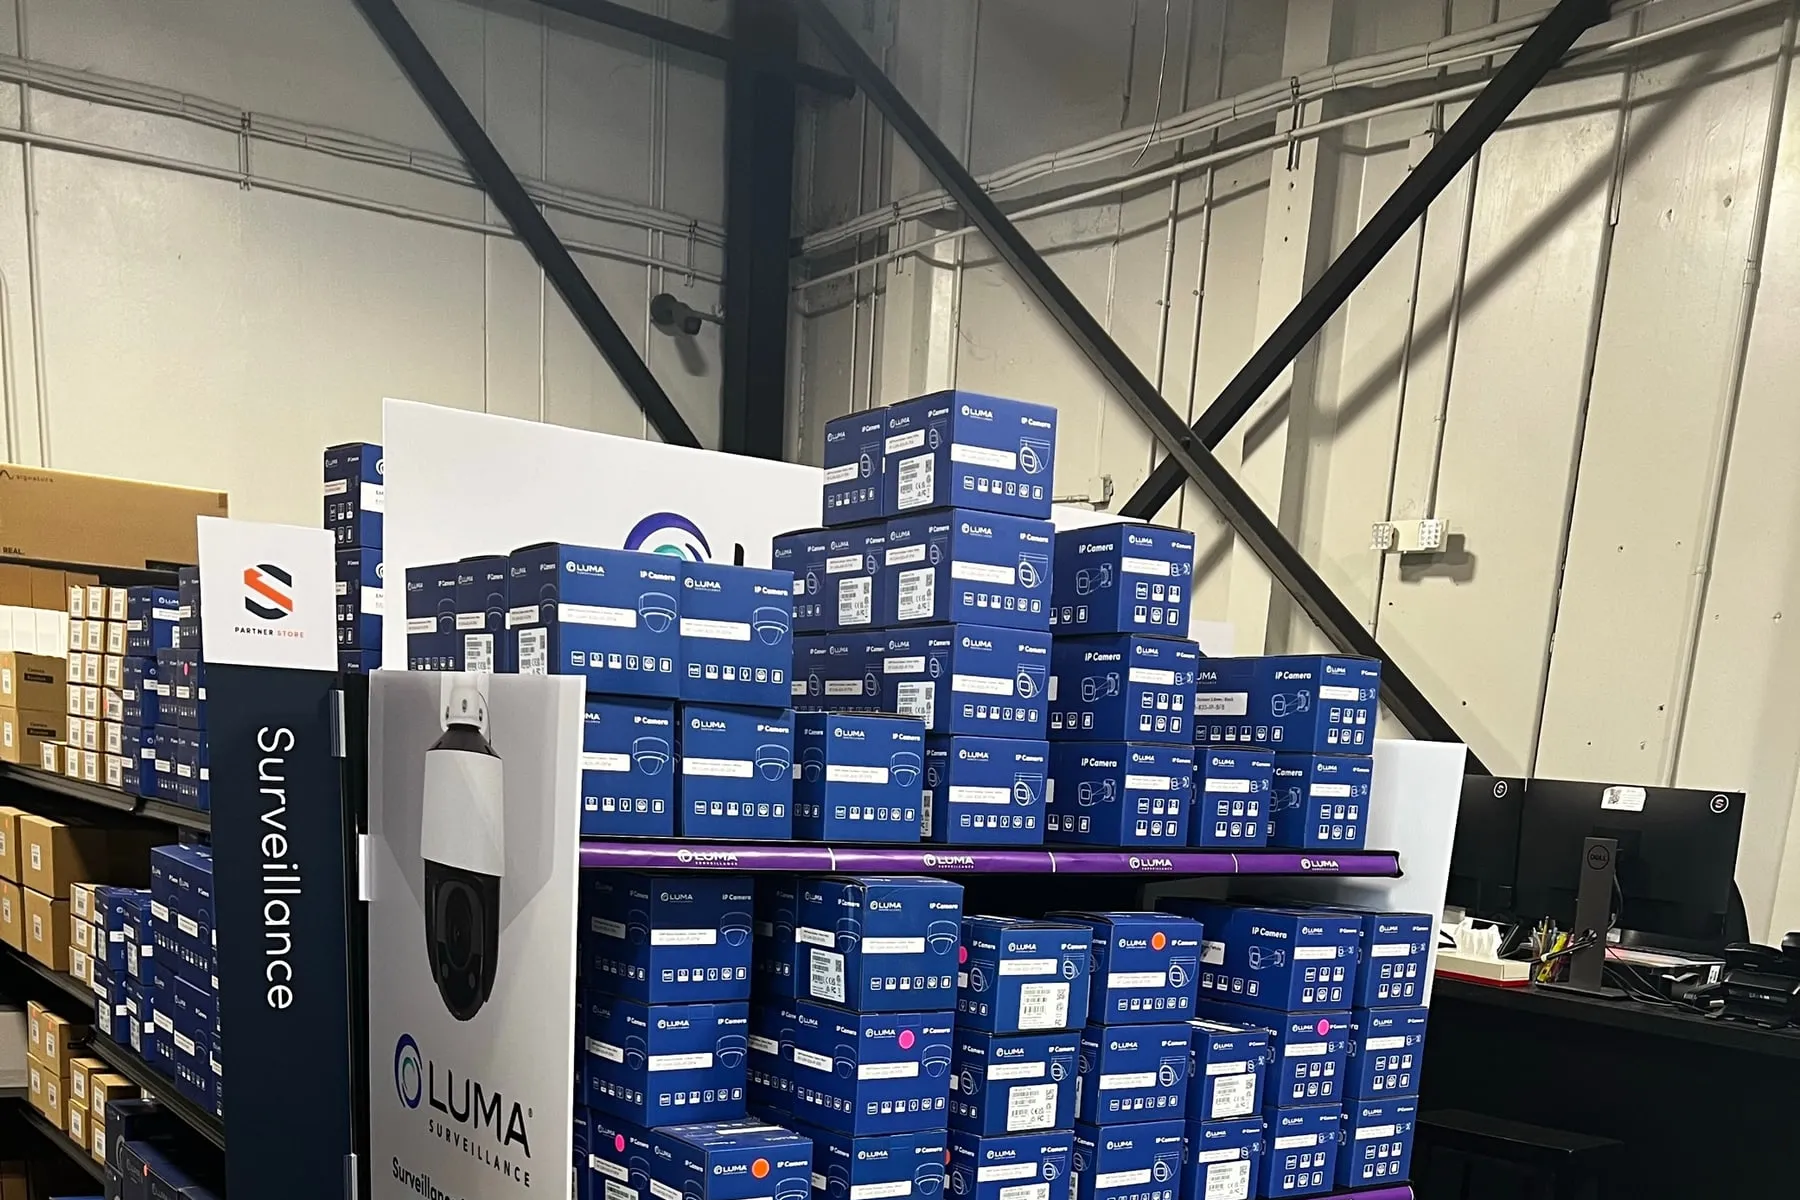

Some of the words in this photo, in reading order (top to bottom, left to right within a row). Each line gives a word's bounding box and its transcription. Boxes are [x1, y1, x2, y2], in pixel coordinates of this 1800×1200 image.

[970, 408, 993, 418] LUMA
[969, 525, 992, 535] LUMA
[1079, 545, 1087, 554] IP
[1087, 543, 1114, 553] Camera
[577, 564, 605, 574] LUMA
[648, 572, 676, 582] Camera
[694, 581, 721, 590] LUMA
[234, 626, 274, 636] PARTNER
[277, 630, 304, 639] STORE
[1085, 652, 1092, 661] IP
[1093, 652, 1121, 661] Camera
[1275, 671, 1283, 680] IP
[1283, 671, 1312, 680] Camera
[701, 721, 726, 729] LUMA
[765, 725, 789, 734] Camera
[842, 730, 865, 738] LUMA
[1081, 758, 1089, 766] IP
[1090, 758, 1117, 767] Camera
[1276, 768, 1303, 777] Camera
[694, 849, 738, 861] LUMA
[936, 855, 974, 865] LUMA
[257, 727, 301, 1009] Surveillance
[1140, 858, 1172, 868] LUMA
[1310, 858, 1339, 868] LUMA
[669, 893, 693, 901] LUMA
[878, 901, 902, 909] LUMA
[1252, 926, 1260, 935] IP
[1260, 927, 1288, 939] Camera
[429, 1060, 531, 1158] LUMA
[429, 1119, 530, 1187] SURVEILLANCE
[866, 1150, 888, 1158] LUMA
[722, 1164, 747, 1173] LUMA
